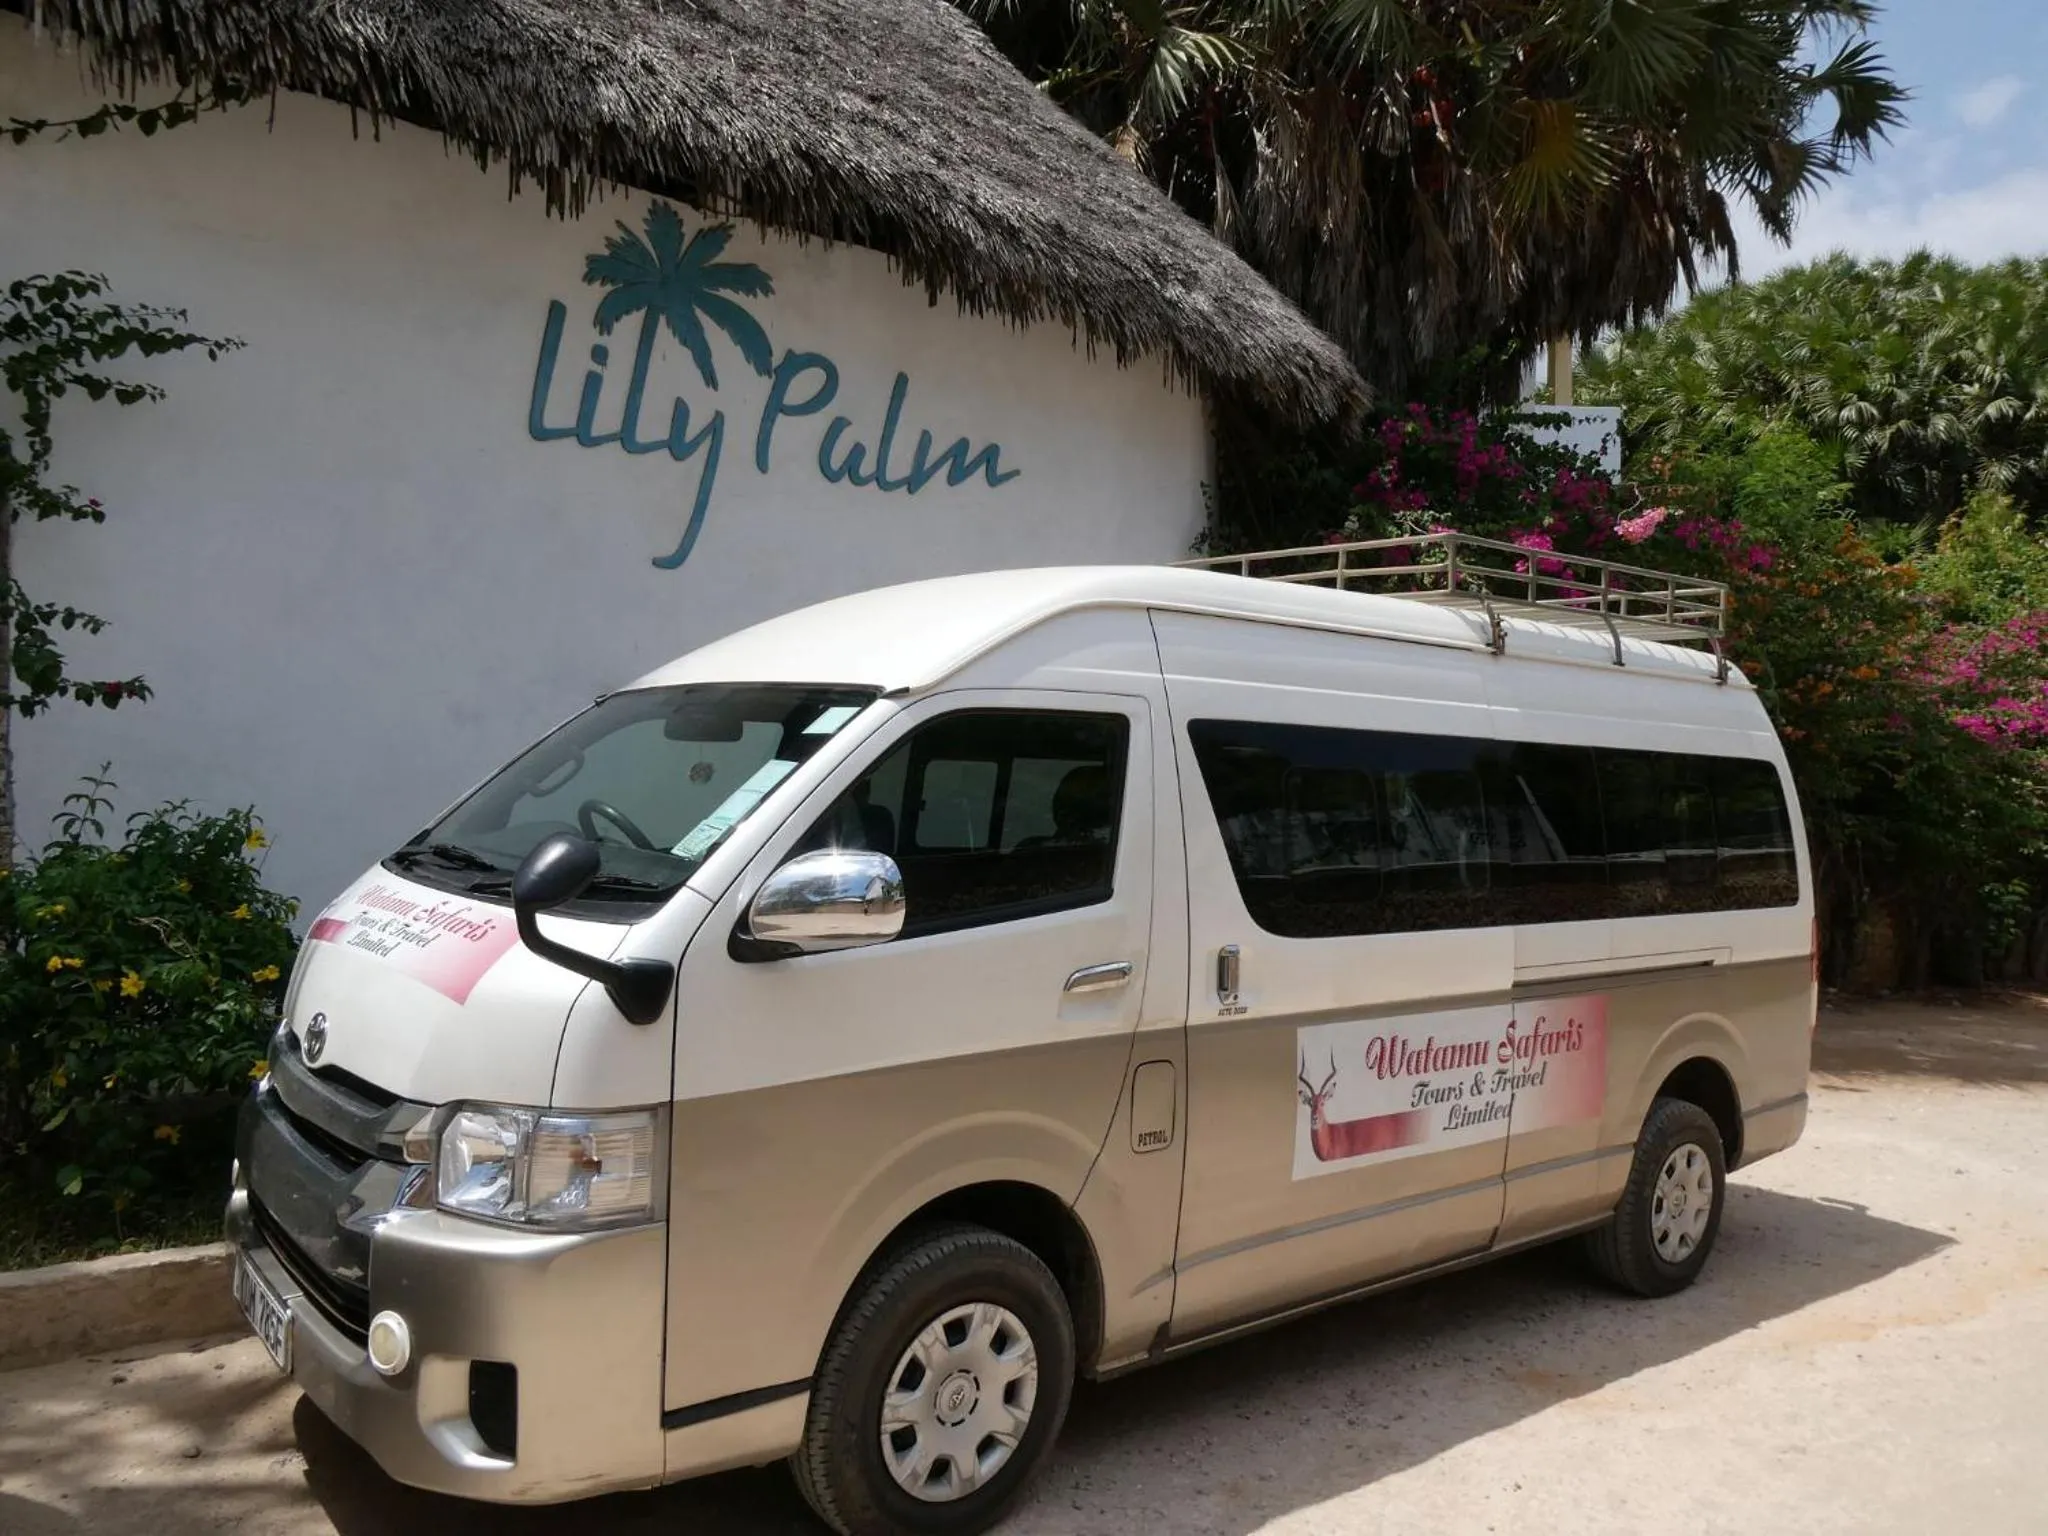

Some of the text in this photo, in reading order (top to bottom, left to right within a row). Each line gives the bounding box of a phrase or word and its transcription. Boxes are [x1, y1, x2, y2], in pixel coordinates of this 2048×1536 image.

[529, 300, 1021, 568] Lily Palm
[378, 918, 396, 933] &
[389, 923, 441, 949] Travel
[413, 901, 497, 942] Safaris
[347, 929, 401, 958] Limited
[1365, 1015, 1584, 1081] Watamu Safaris
[1410, 1061, 1549, 1109] Tours & Travel
[1442, 1094, 1515, 1132] Limited
[1137, 1130, 1168, 1147] PETROL
